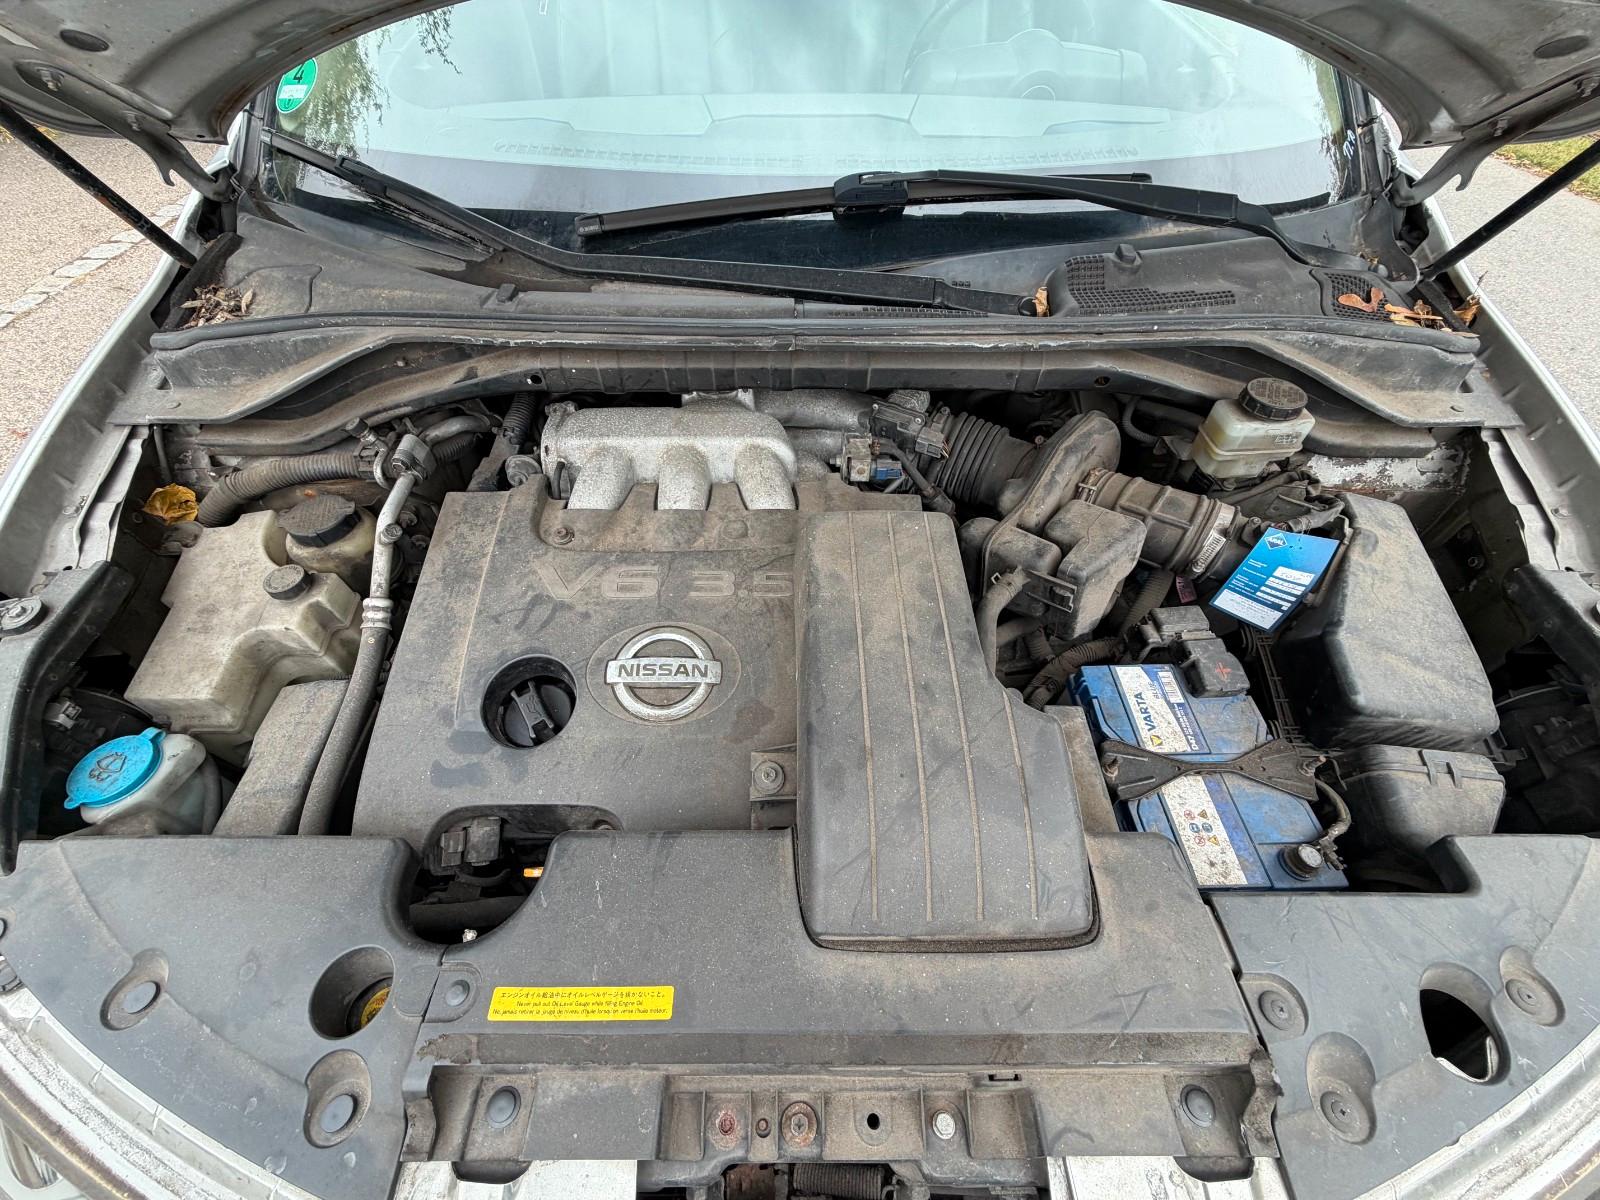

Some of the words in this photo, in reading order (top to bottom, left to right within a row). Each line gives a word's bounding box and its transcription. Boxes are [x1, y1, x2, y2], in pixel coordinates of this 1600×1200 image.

[292, 64, 305, 84] 4
[533, 558, 659, 600] V6
[617, 663, 709, 679] NISSAN
[1133, 691, 1157, 732] VARTA
